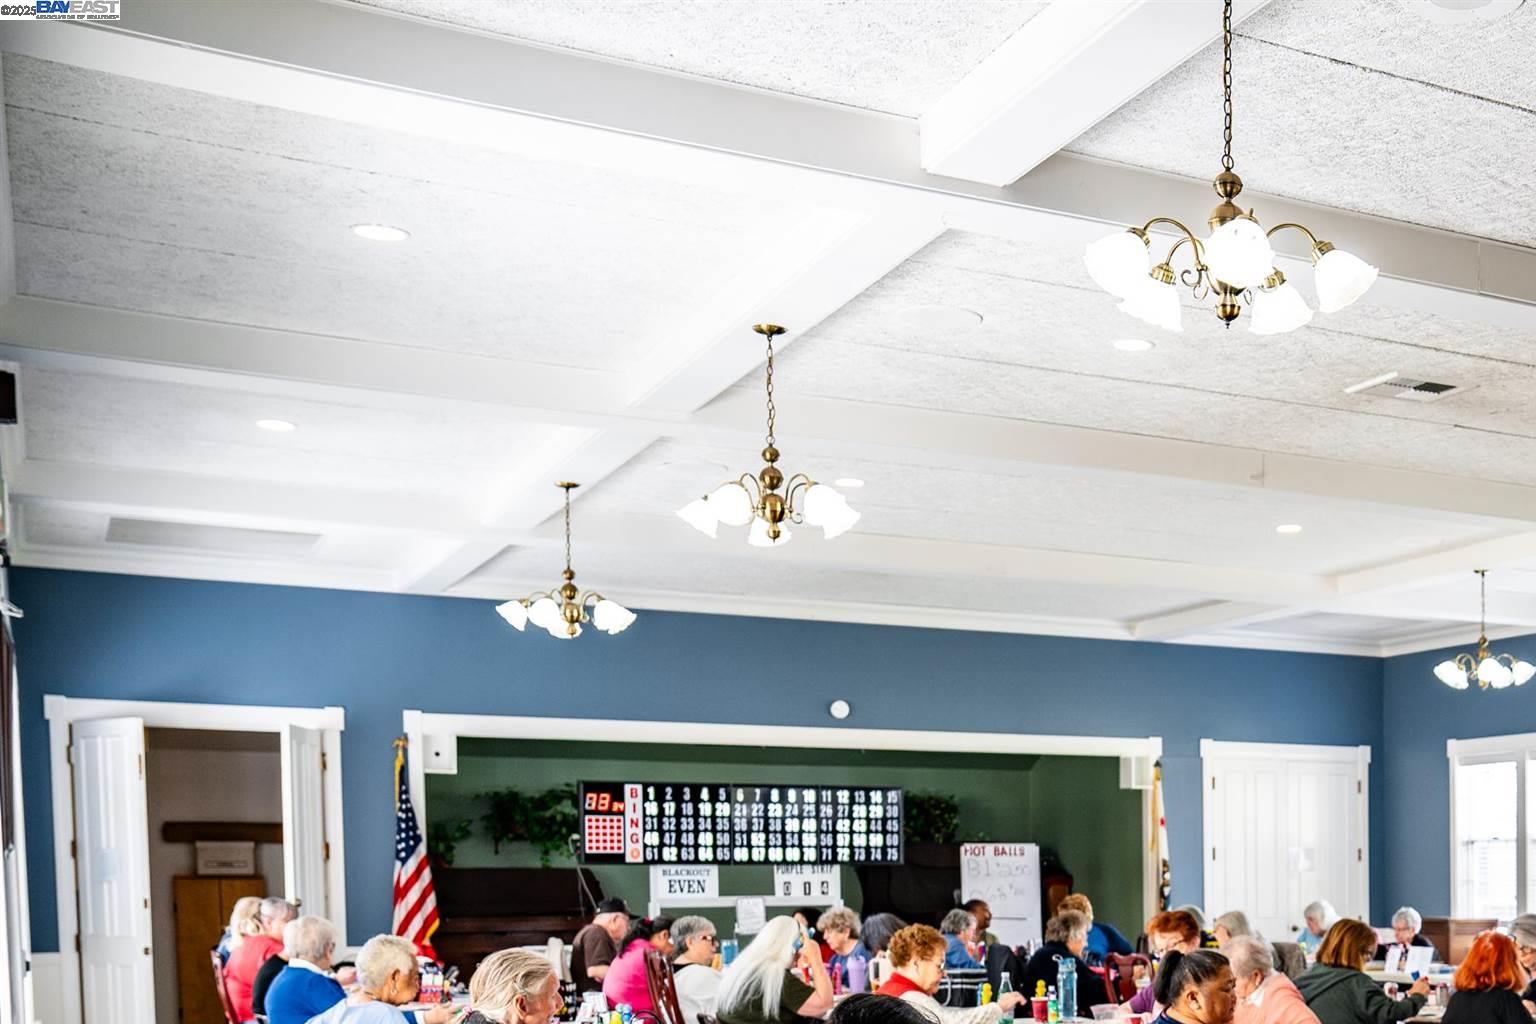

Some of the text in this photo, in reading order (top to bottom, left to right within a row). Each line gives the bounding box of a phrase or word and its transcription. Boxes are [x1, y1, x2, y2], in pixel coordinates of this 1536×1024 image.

[821, 790, 831, 802] 11
[836, 790, 849, 804] 12
[855, 791, 865, 803] 13
[869, 790, 883, 804] 14
[887, 790, 898, 803] 15
[663, 802, 675, 816] 17
[682, 803, 693, 815] 18
[734, 803, 747, 817] 21
[751, 803, 764, 817] 22
[785, 803, 799, 817] 24
[802, 804, 816, 817] 25
[820, 804, 833, 817] 26
[837, 805, 849, 817] 27
[886, 805, 898, 817] 30
[645, 817, 657, 830] 31
[663, 817, 676, 830] 32
[681, 817, 694, 830] 33
[699, 818, 711, 830] 34
[716, 818, 729, 830] 35
[752, 818, 764, 831] 37
[821, 819, 832, 831] 41
[836, 819, 850, 832] 42
[853, 819, 867, 832] 43
[870, 820, 882, 831] 44
[886, 820, 898, 832] 45
[664, 832, 676, 845] 47
[681, 832, 694, 845] 48
[717, 833, 729, 845] 50
[735, 833, 747, 845] 51
[769, 833, 782, 846] 53
[786, 833, 799, 846] 54
[820, 834, 833, 846] 56
[886, 834, 898, 846] 60
[646, 847, 658, 860] 61
[681, 847, 694, 860] 63
[717, 847, 730, 860] 65
[822, 848, 831, 860] 71
[837, 847, 850, 861] 72
[855, 848, 865, 860] 73
[871, 848, 881, 860] 74
[887, 848, 898, 860] 75
[964, 846, 985, 856] HOT
[662, 868, 711, 877] BLACKOUT
[668, 879, 706, 894] EVEN
